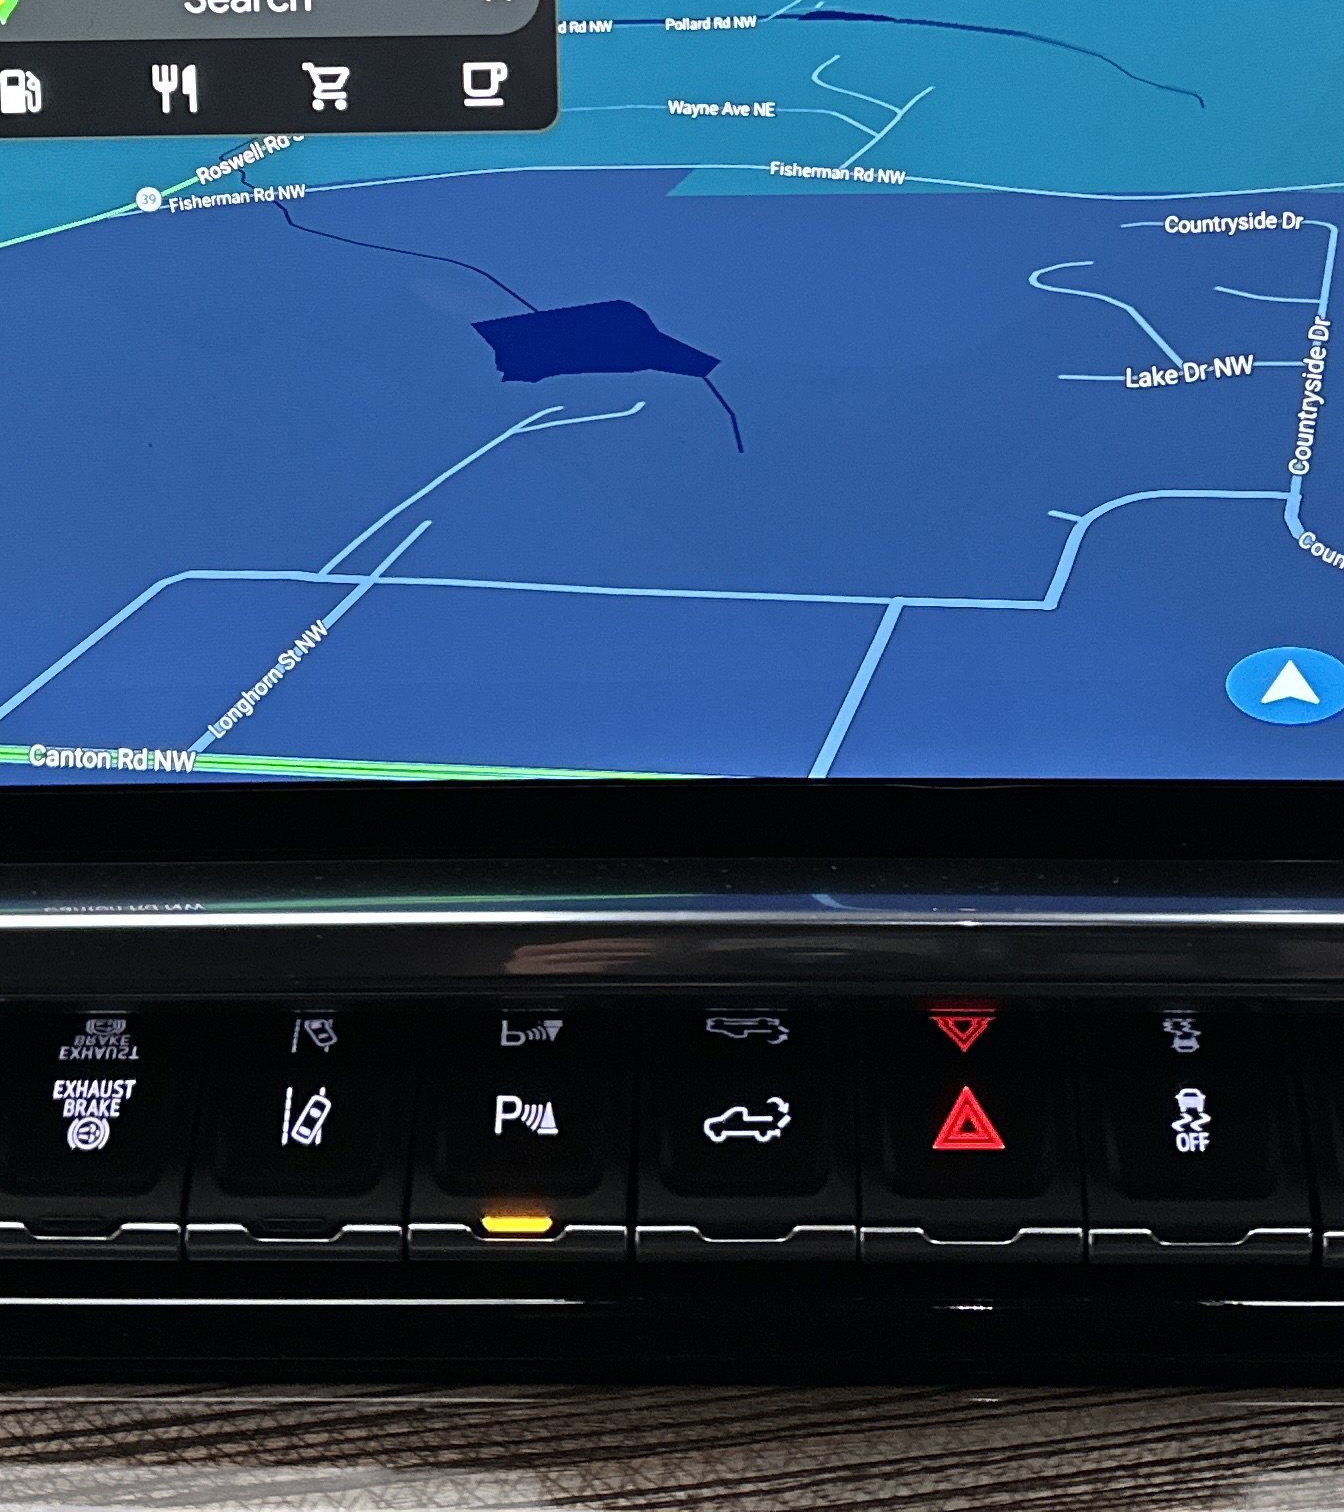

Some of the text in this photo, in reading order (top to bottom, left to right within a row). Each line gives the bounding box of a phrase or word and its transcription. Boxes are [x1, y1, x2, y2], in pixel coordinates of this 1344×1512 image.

[569, 21, 587, 34] Rd
[589, 19, 613, 34] NW
[665, 15, 757, 32] Pollard Rd NW
[667, 99, 776, 119] Wayne Ave NE
[195, 135, 291, 186] Roswell Rd
[769, 160, 907, 186] Fisherman Rd NW
[140, 193, 157, 206] 39
[168, 183, 306, 214] Fisherman Rd NW
[1164, 210, 1305, 236] Countryside Dr
[1125, 354, 1255, 389] Lake Dr NW
[1287, 315, 1332, 476] Countryside Dr
[207, 618, 329, 739] Longhorn St NW
[29, 743, 197, 773] Canton Rd NW
[52, 1078, 137, 1100] EXHAUST
[62, 1098, 122, 1118] BRAKE
[495, 1095, 522, 1135] P
[1175, 1131, 1211, 1153] OFF
